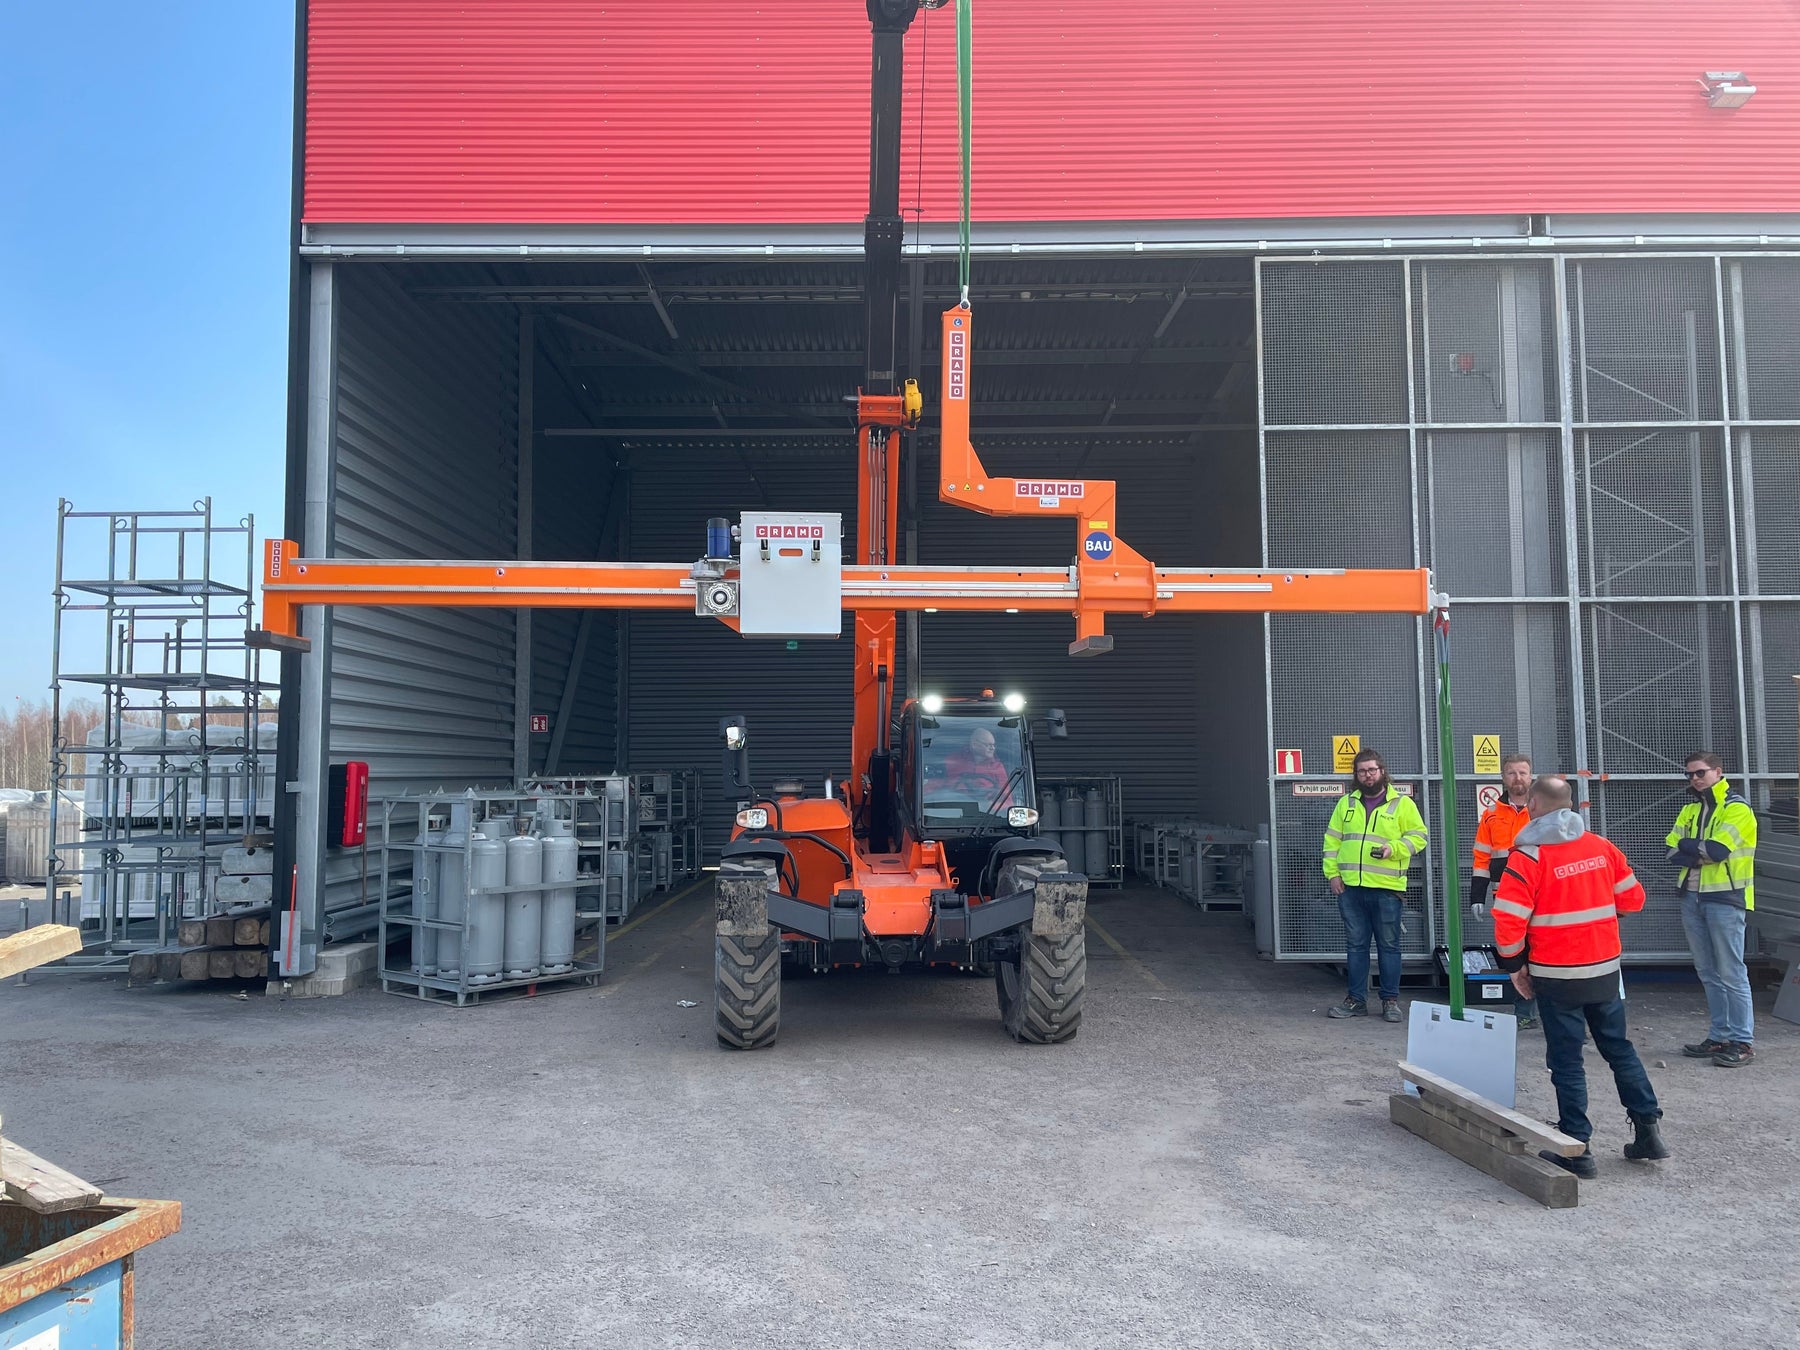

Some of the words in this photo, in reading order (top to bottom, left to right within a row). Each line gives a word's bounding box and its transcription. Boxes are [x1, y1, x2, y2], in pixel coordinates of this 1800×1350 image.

[951, 333, 963, 396] CRAMO
[1018, 484, 1082, 496] CRAMO
[757, 526, 822, 538] CRAMO
[1085, 540, 1112, 552] BAU
[1298, 785, 1319, 793] Tyhjät
[1554, 857, 1605, 878] CRAMO
